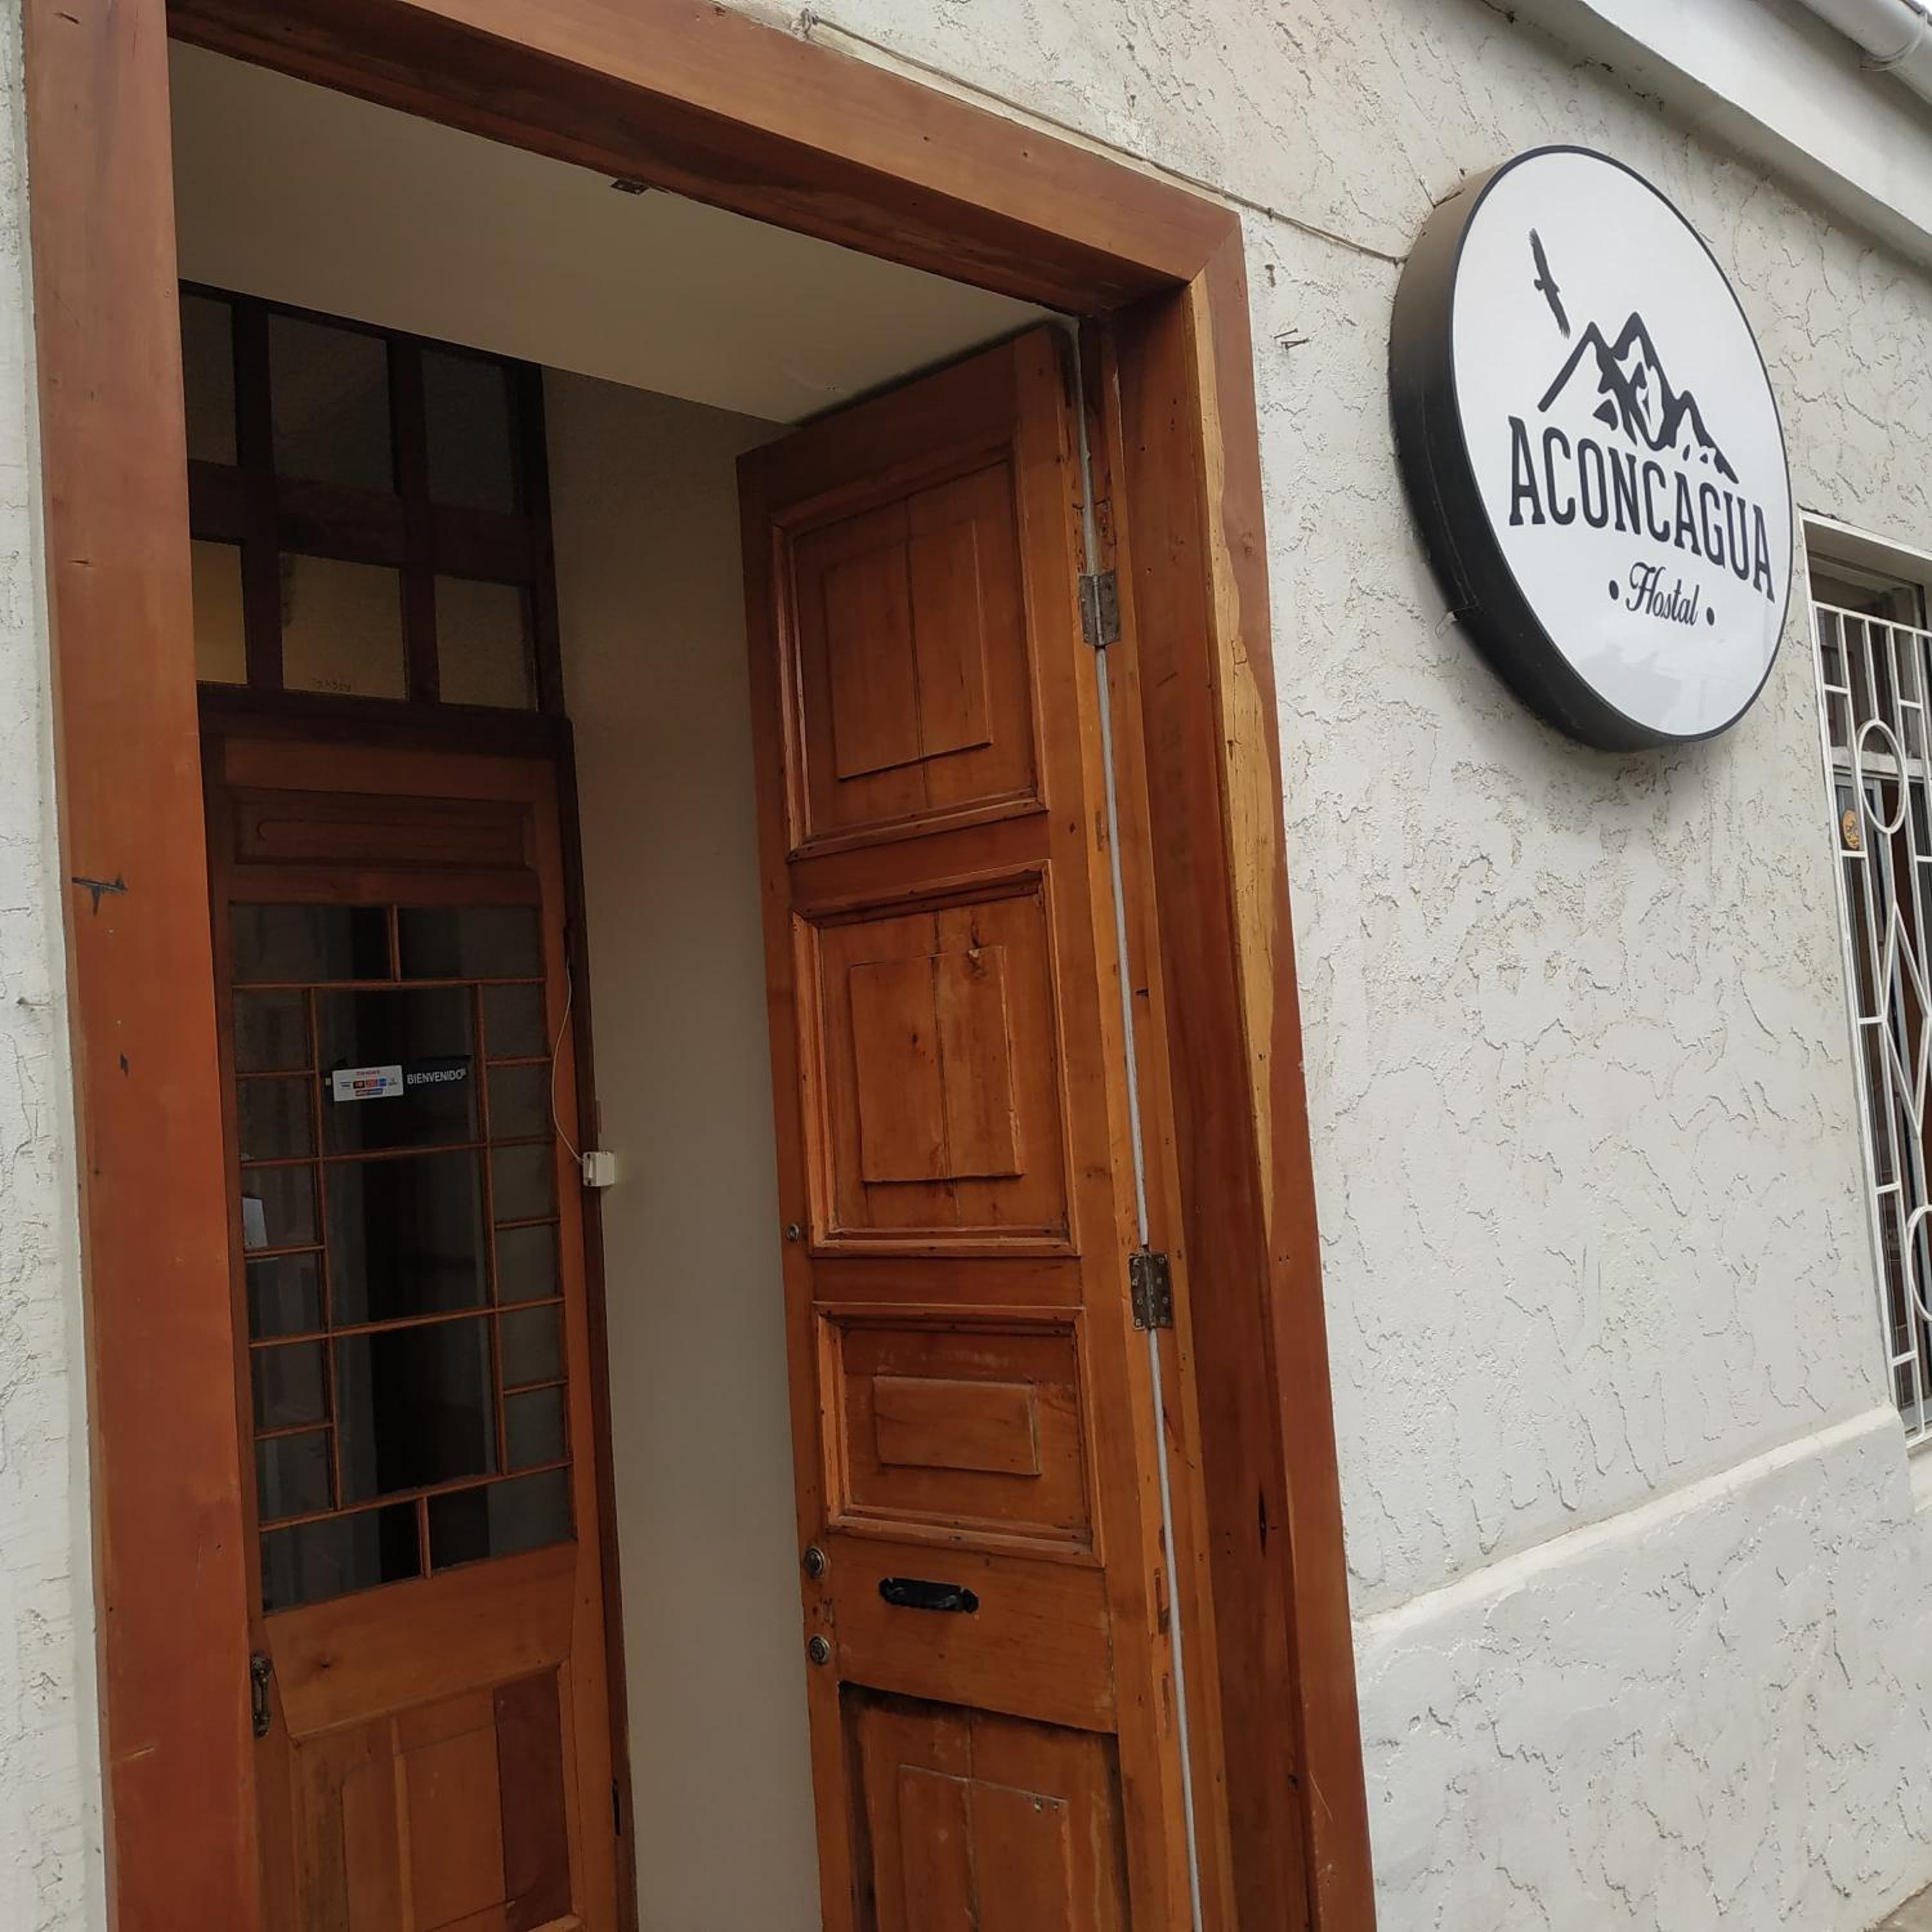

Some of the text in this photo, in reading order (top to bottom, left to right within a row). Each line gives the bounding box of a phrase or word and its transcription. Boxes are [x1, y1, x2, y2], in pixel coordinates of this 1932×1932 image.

[1508, 415, 1775, 603] ACONCAGUA
[1625, 562, 1700, 626] Hostal
[406, 1069, 464, 1084] BIENVENIDO
